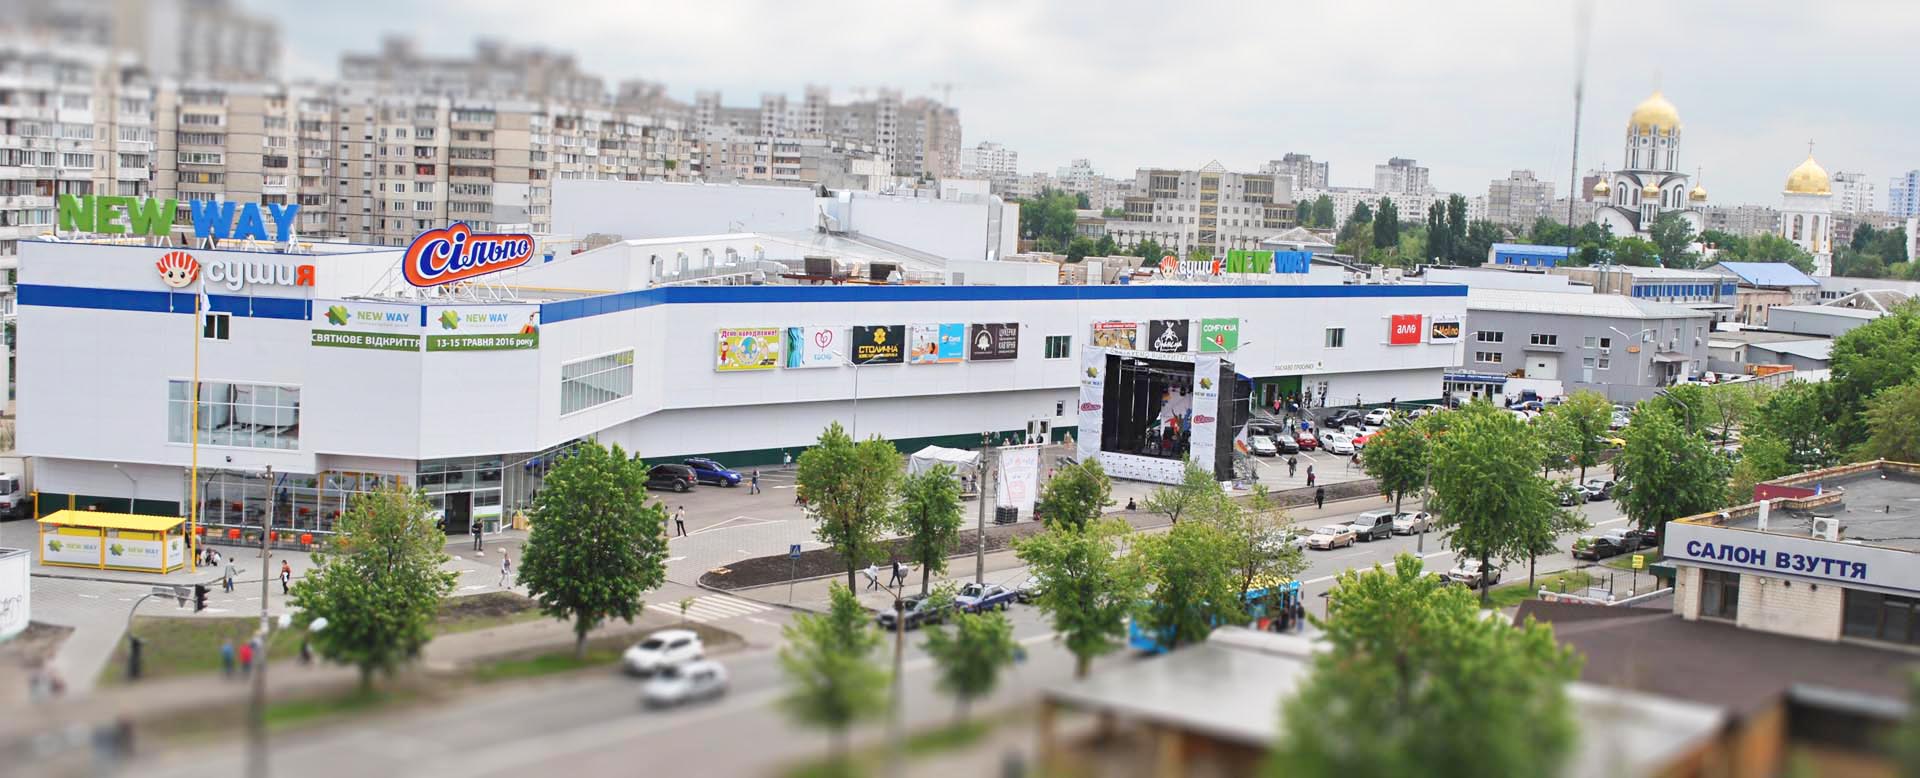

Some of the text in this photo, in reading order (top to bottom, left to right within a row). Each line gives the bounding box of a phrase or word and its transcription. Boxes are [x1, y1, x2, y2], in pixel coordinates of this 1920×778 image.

[59, 193, 301, 242] NEW WAY
[419, 232, 529, 277] Сільпо
[1226, 250, 1313, 274] NEW WAY
[206, 260, 315, 291] сушия
[357, 310, 409, 323] NEW WAY
[466, 313, 508, 323] NEW WAY
[312, 333, 420, 347] СВЯТКОВЕ ВІДКРИТТЯ
[436, 337, 534, 348] 13-15 ТРАВНЯ 2016 року
[858, 345, 898, 353] СТОЛИЧНА
[1686, 540, 1867, 580] САЛОН ВЗУТТЯ
